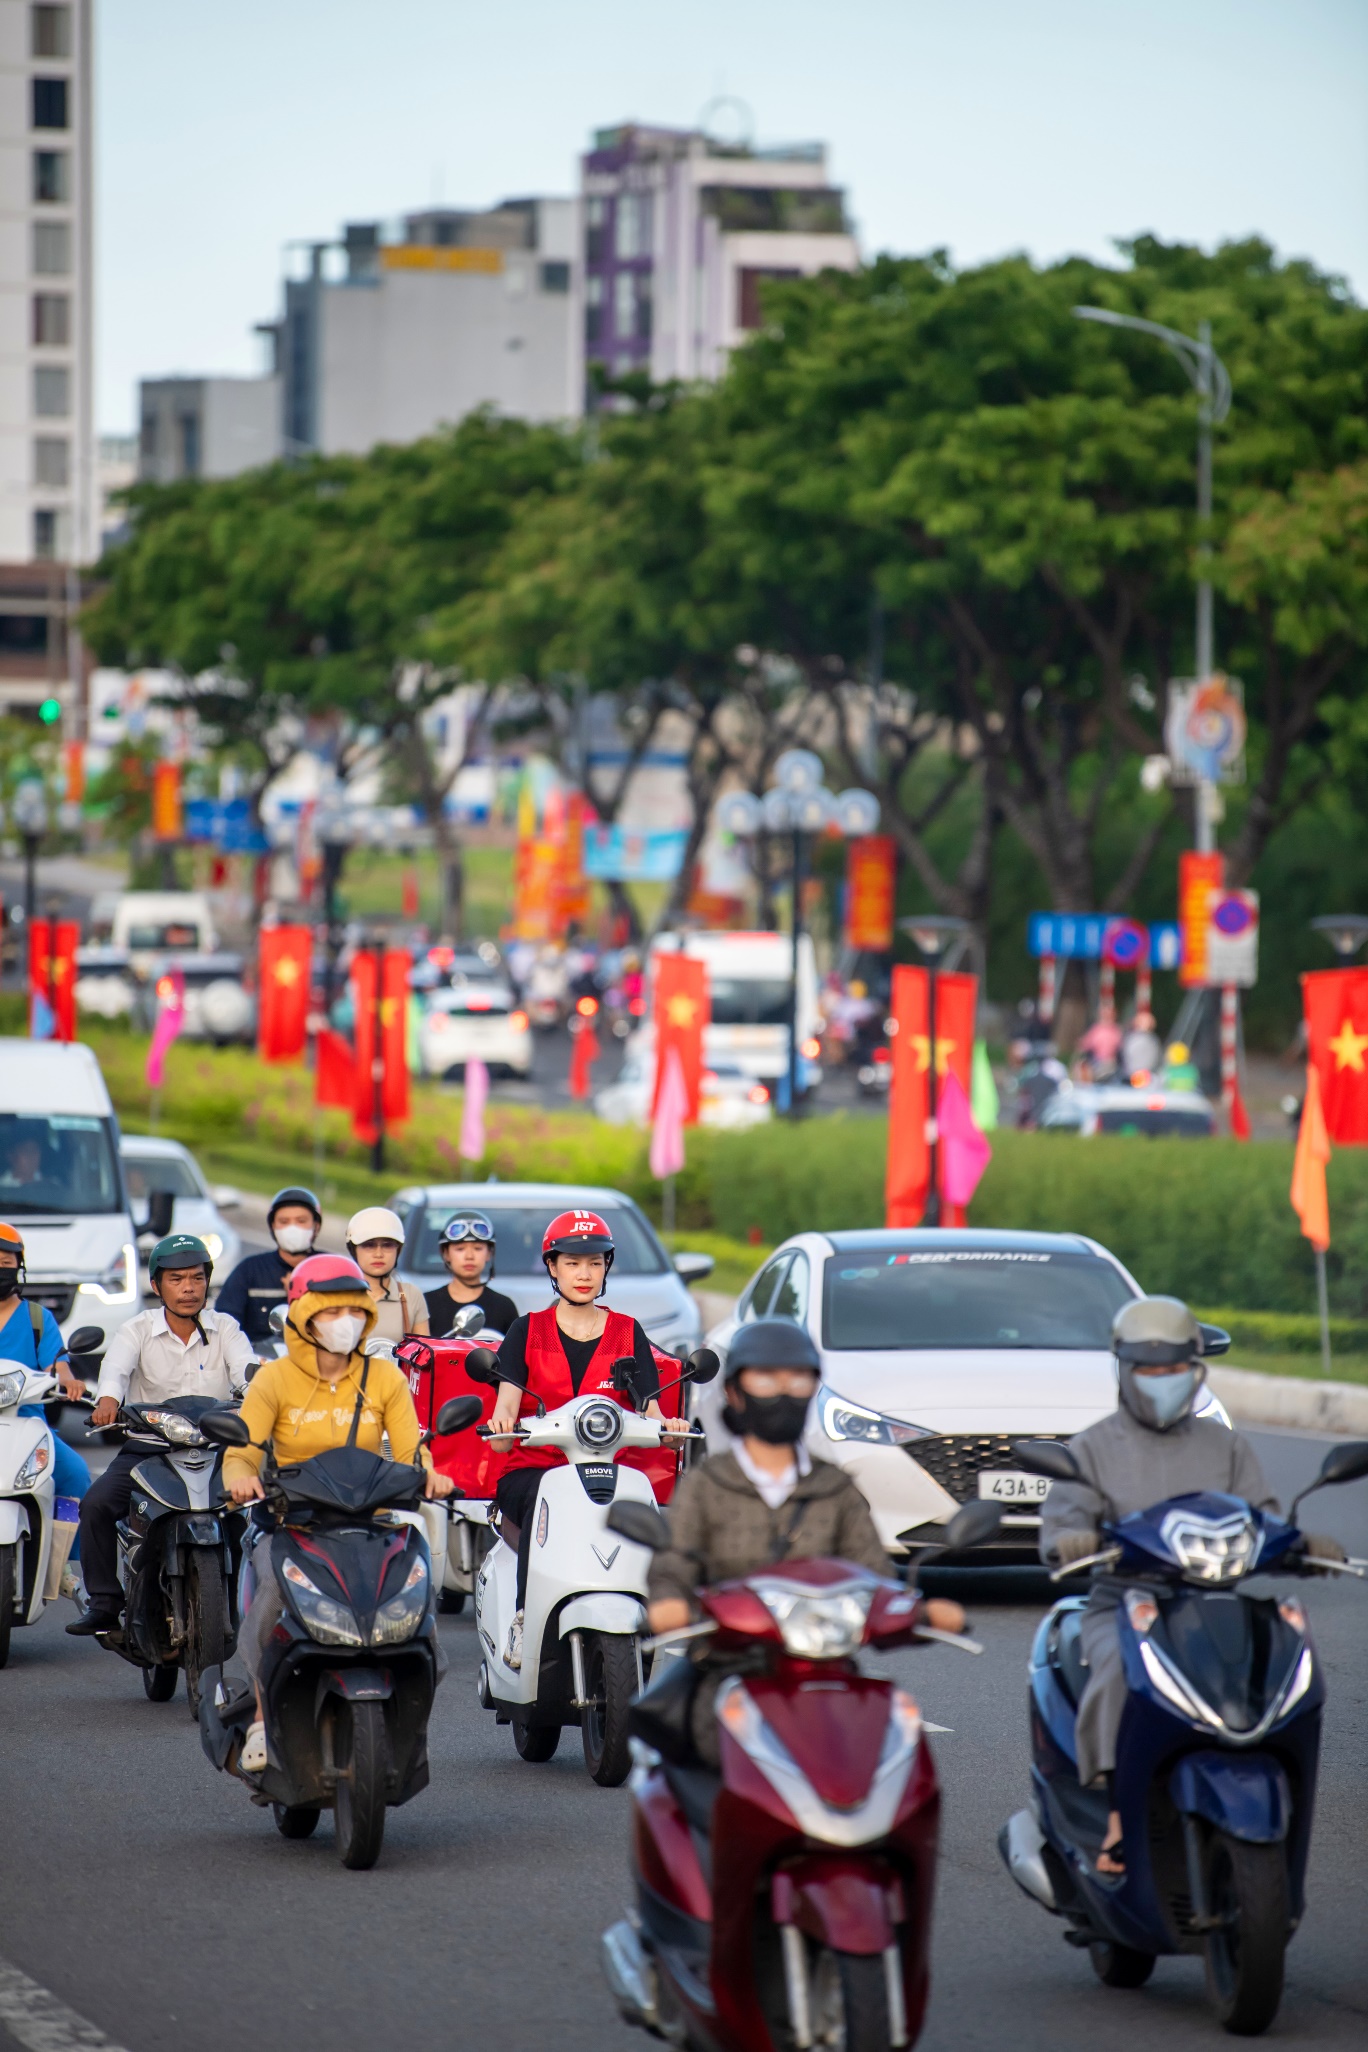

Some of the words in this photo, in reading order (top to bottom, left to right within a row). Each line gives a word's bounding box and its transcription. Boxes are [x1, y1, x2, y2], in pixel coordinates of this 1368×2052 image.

[570, 1221, 598, 1233] J&T
[908, 1252, 1052, 1264] PERFORMANCE
[992, 1479, 1054, 1496] 43A-8
